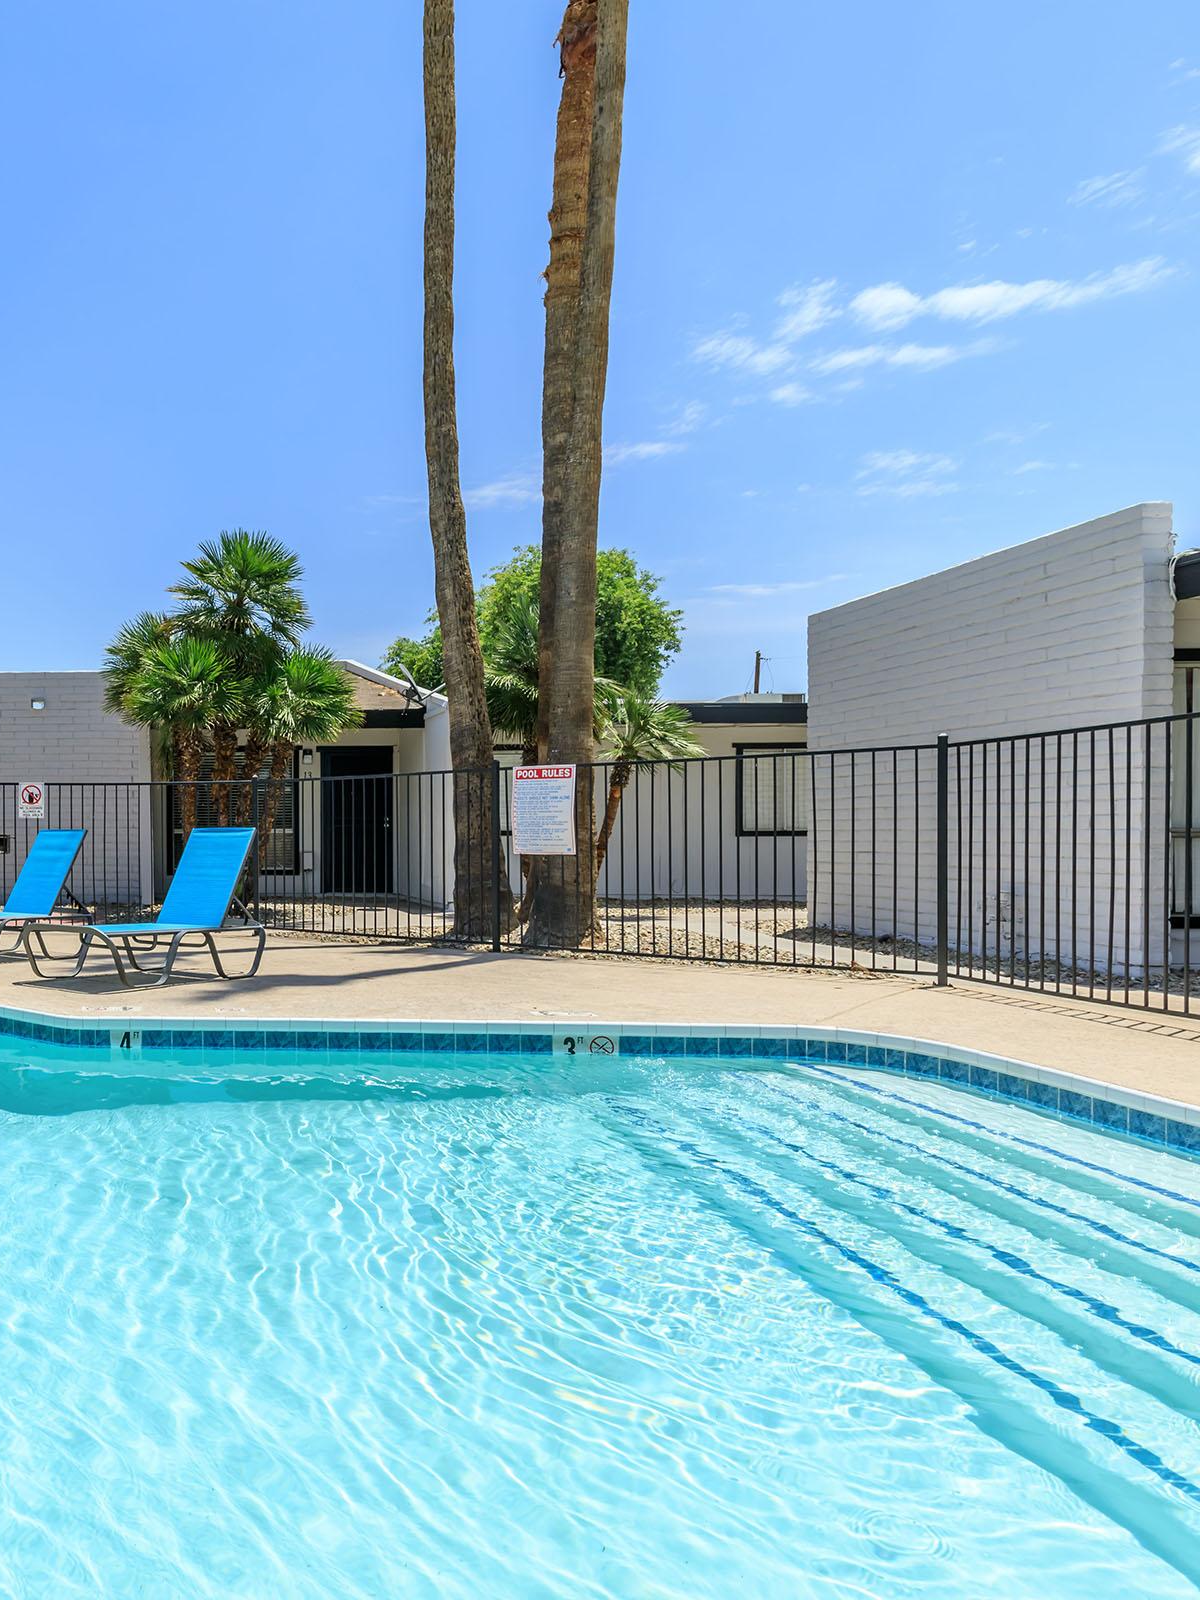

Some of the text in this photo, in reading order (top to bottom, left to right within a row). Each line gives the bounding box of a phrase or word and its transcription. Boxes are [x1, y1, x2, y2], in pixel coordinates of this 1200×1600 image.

[517, 768, 570, 779] POOL RULES
[120, 1031, 140, 1048] 4 FT
[563, 1036, 584, 1055] 3 FT
